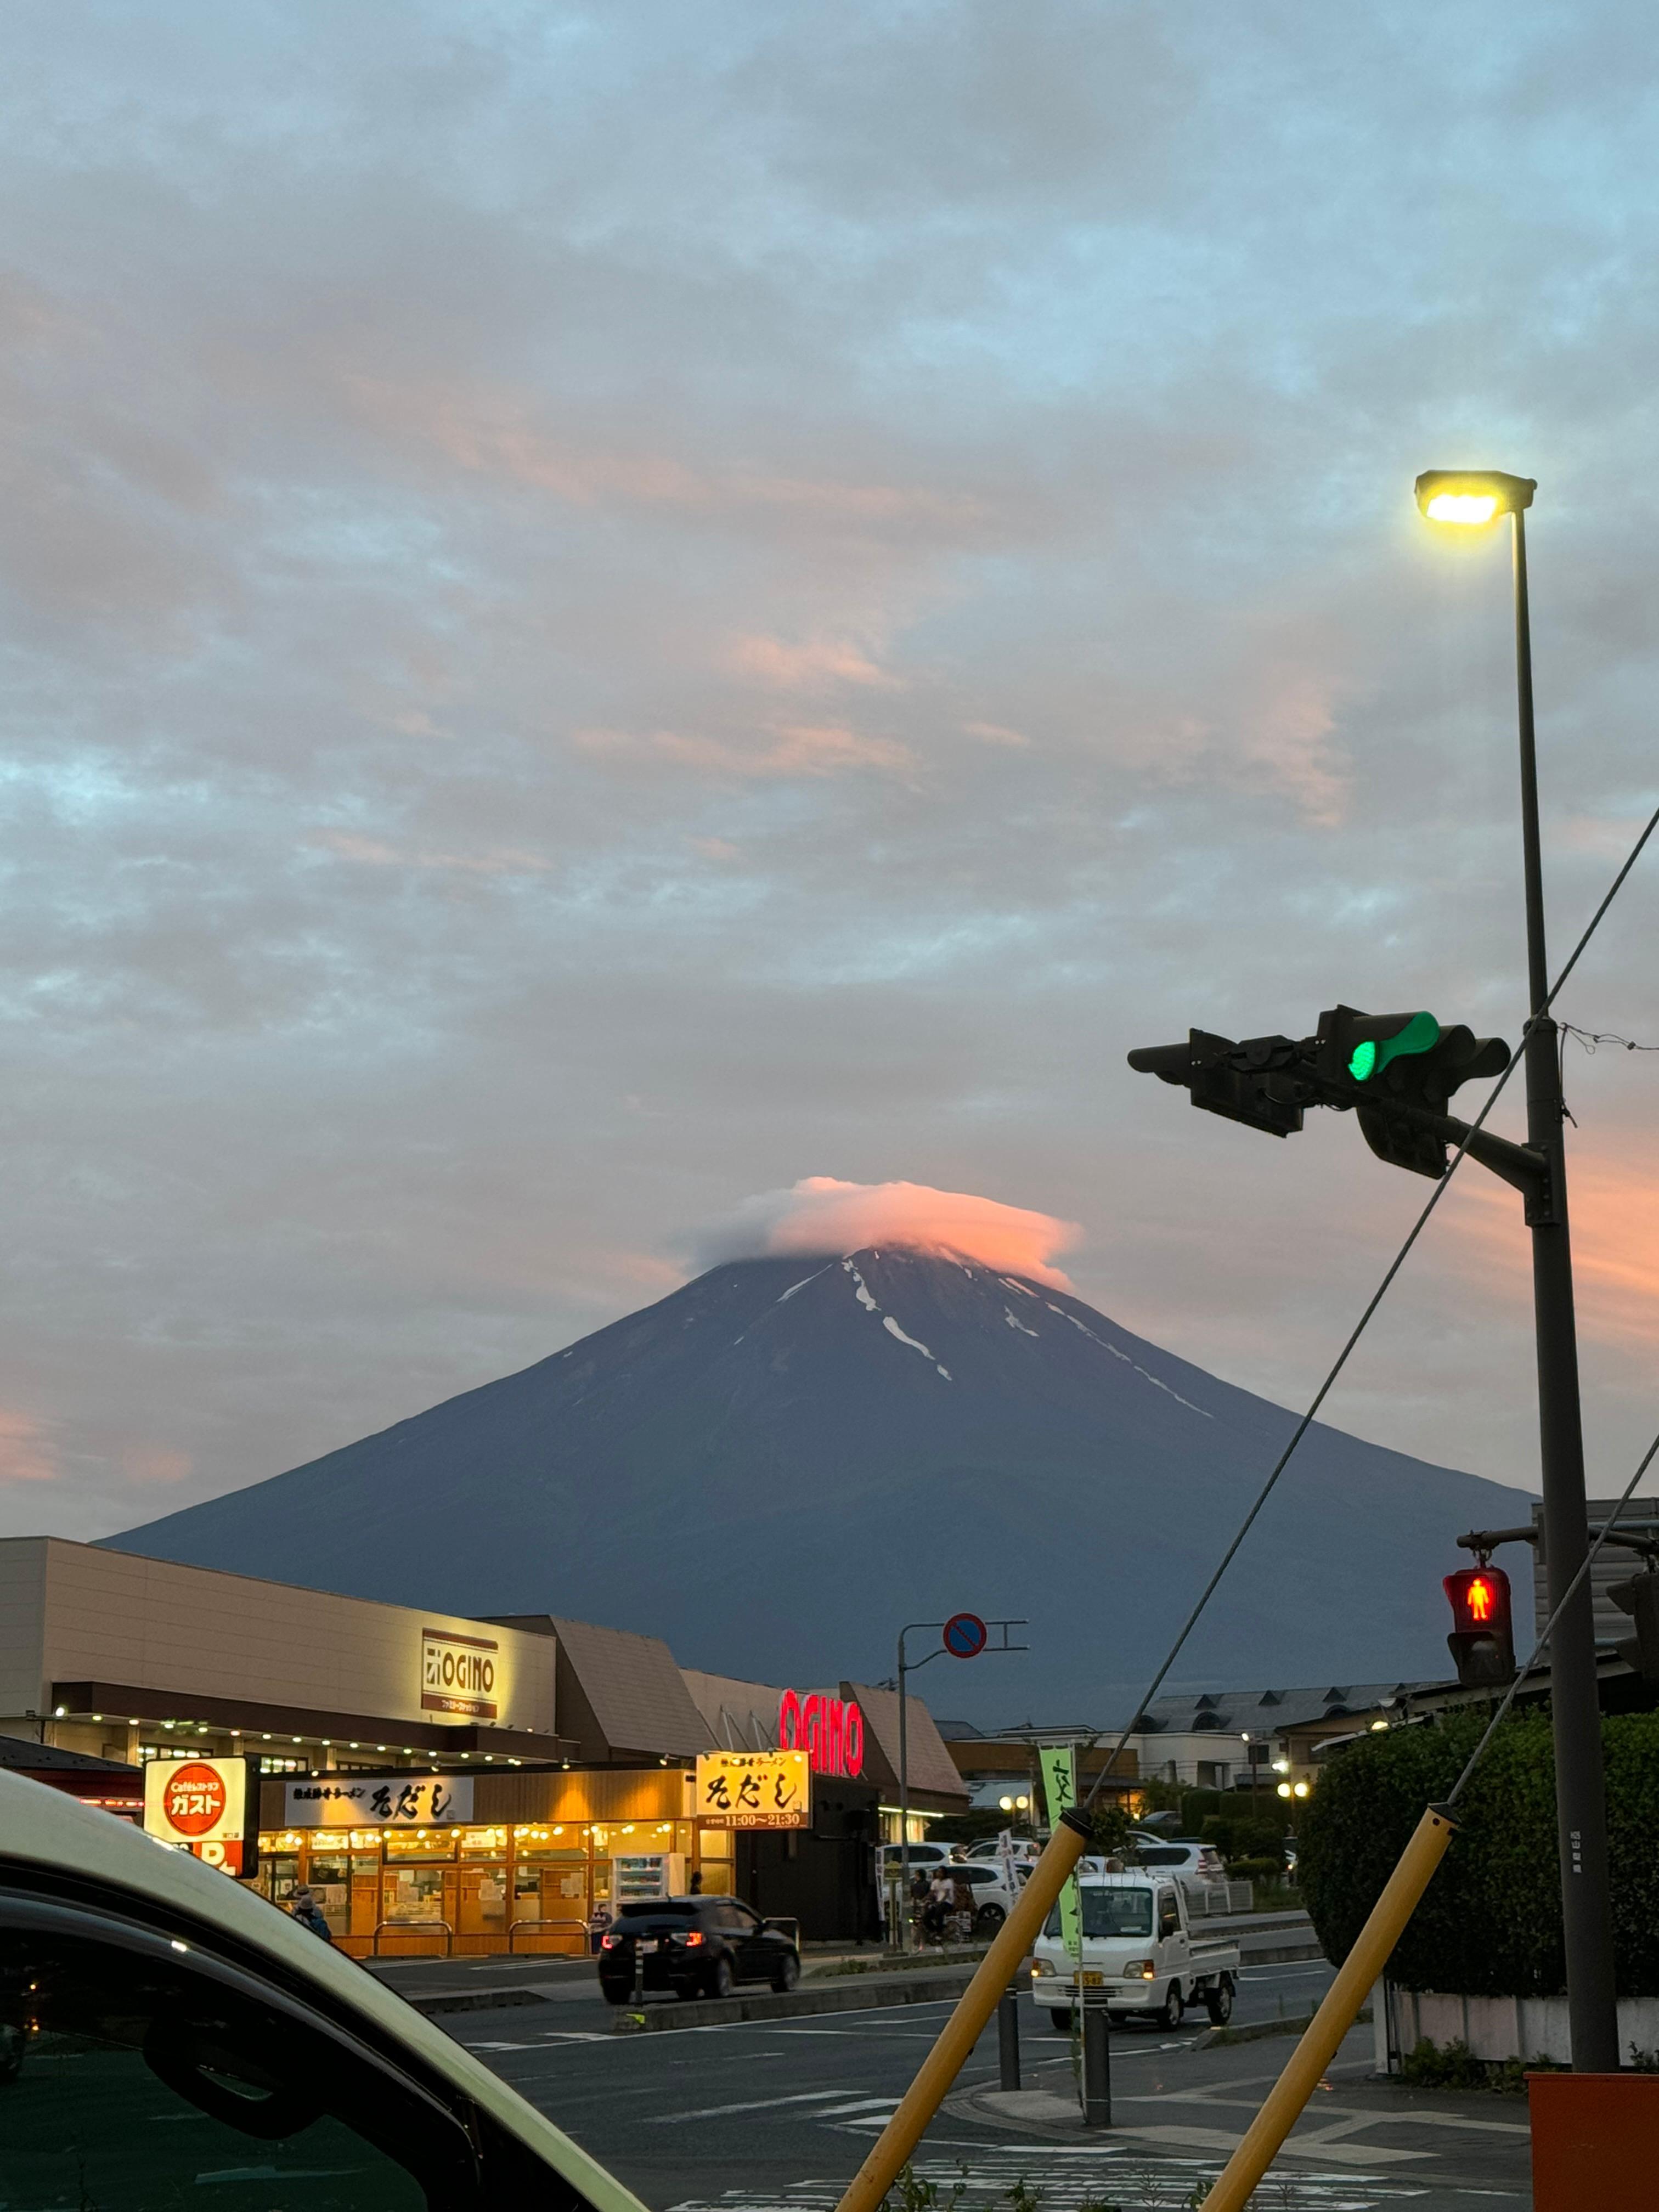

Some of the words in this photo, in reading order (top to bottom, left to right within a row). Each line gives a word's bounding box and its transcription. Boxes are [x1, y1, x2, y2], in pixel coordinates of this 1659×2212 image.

[443, 1651, 494, 1693] OGINO
[779, 1688, 864, 1778] OGINO
[171, 1794, 220, 1815] ガスト
[370, 1784, 452, 1820] そだし
[706, 1773, 797, 1810] そだし
